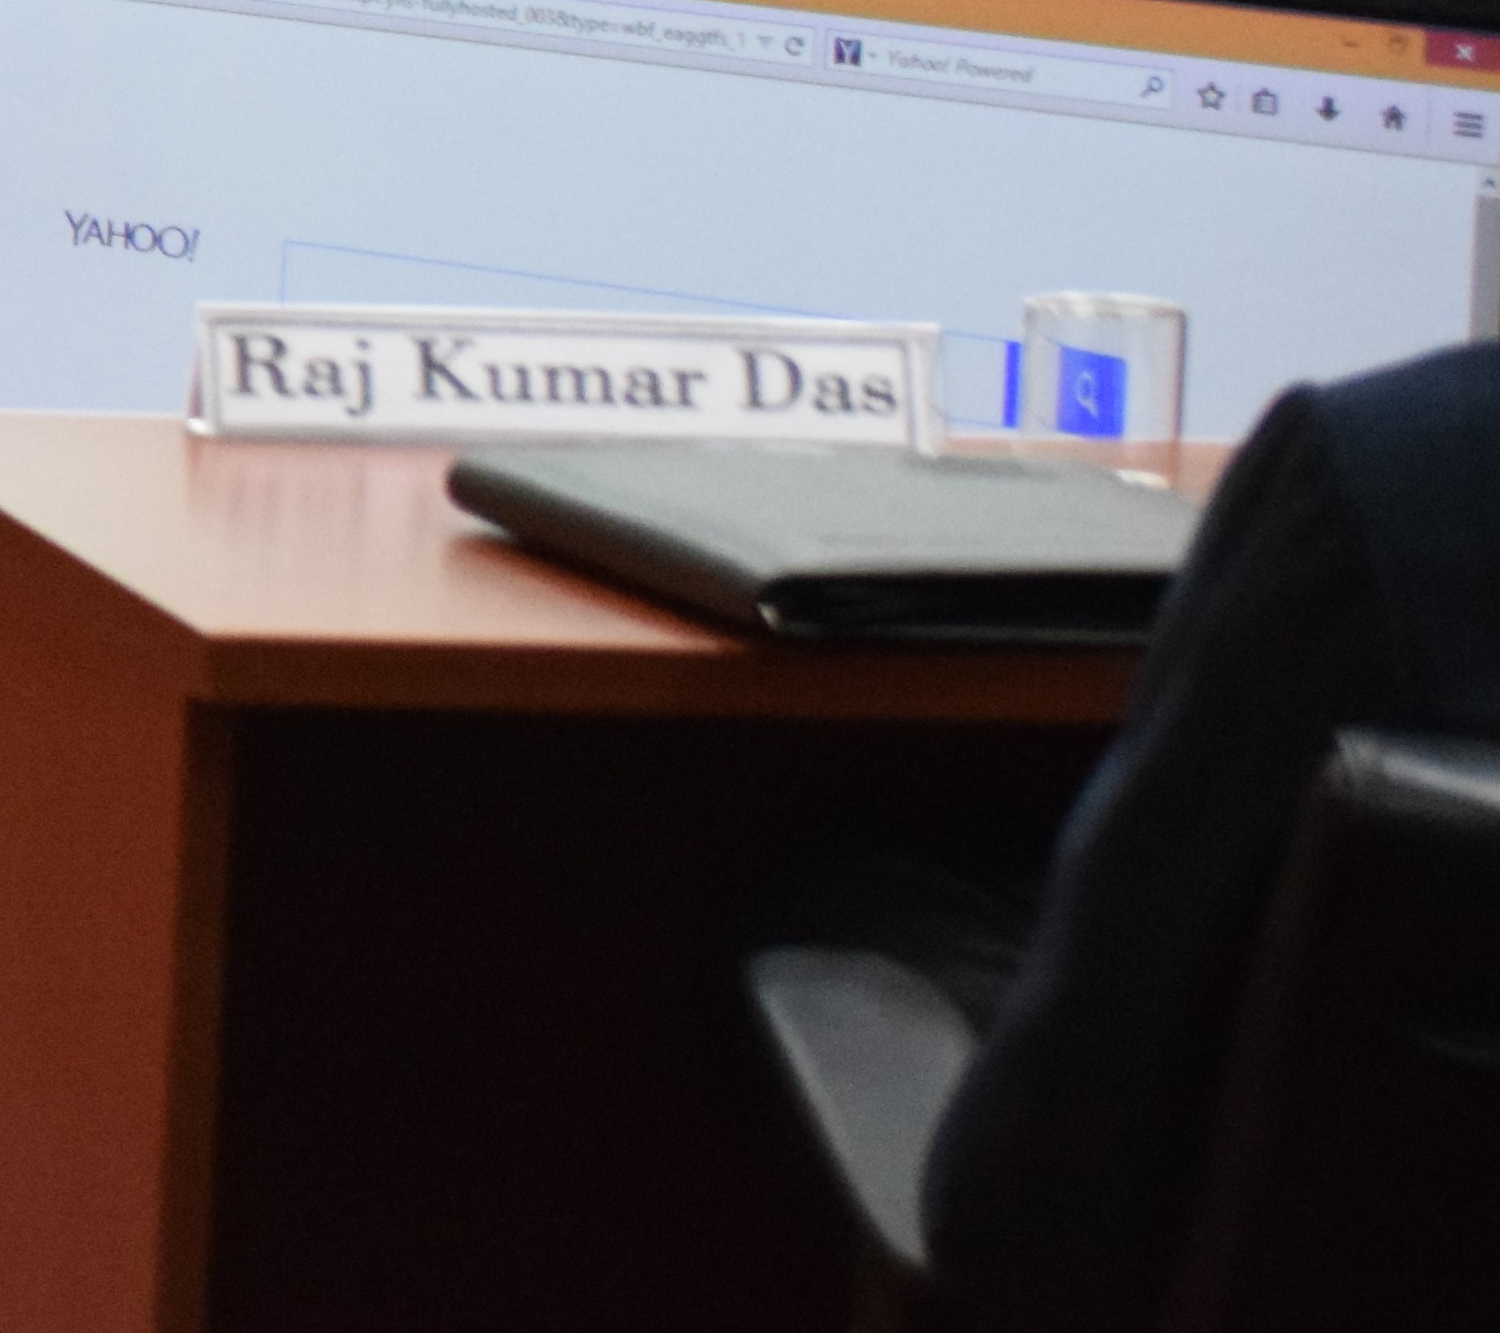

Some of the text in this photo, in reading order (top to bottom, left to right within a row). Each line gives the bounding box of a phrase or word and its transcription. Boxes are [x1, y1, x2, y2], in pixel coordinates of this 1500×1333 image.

[64, 208, 201, 263] YAHOO!
[226, 330, 900, 417] Raj Kumar Das
